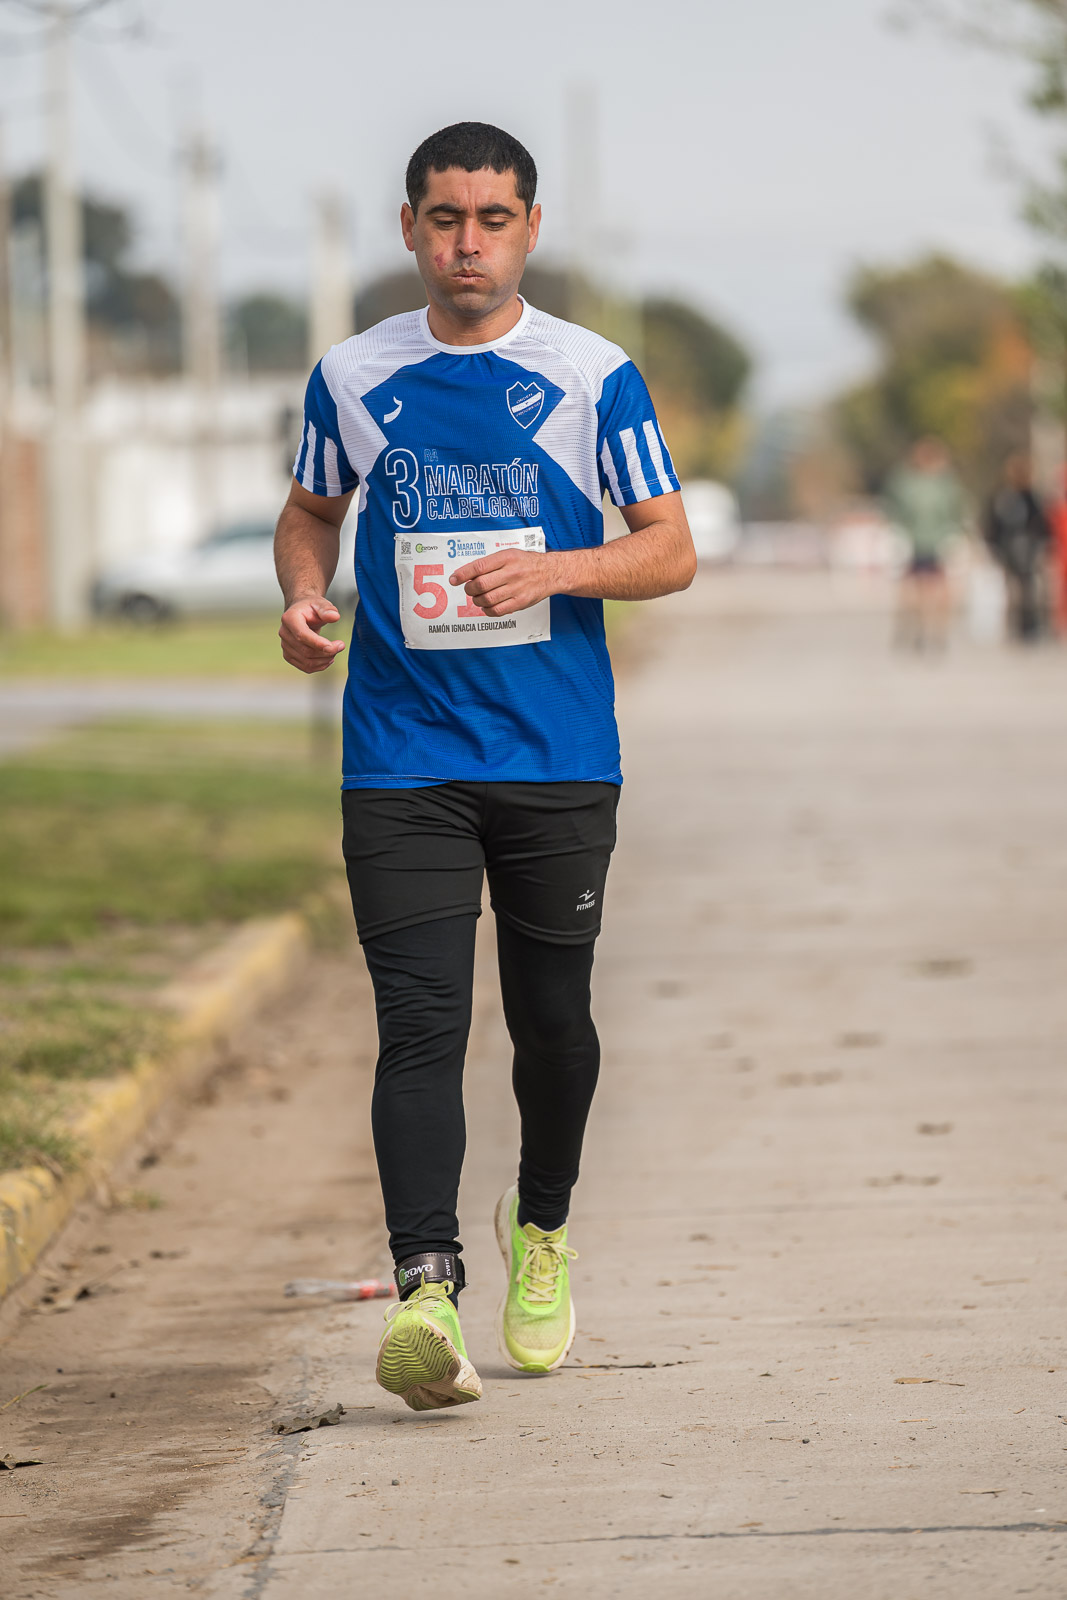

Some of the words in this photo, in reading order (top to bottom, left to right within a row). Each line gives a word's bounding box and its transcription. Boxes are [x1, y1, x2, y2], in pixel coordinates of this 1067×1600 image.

[424, 458, 539, 496] MARATÓN
[385, 448, 422, 529] 3
[447, 539, 457, 558] 3
[457, 541, 485, 550] MARATÓN
[428, 623, 450, 633] RAMÓN
[451, 623, 477, 633] IGNACIA
[477, 619, 517, 631] LEGUIZAMÓN
